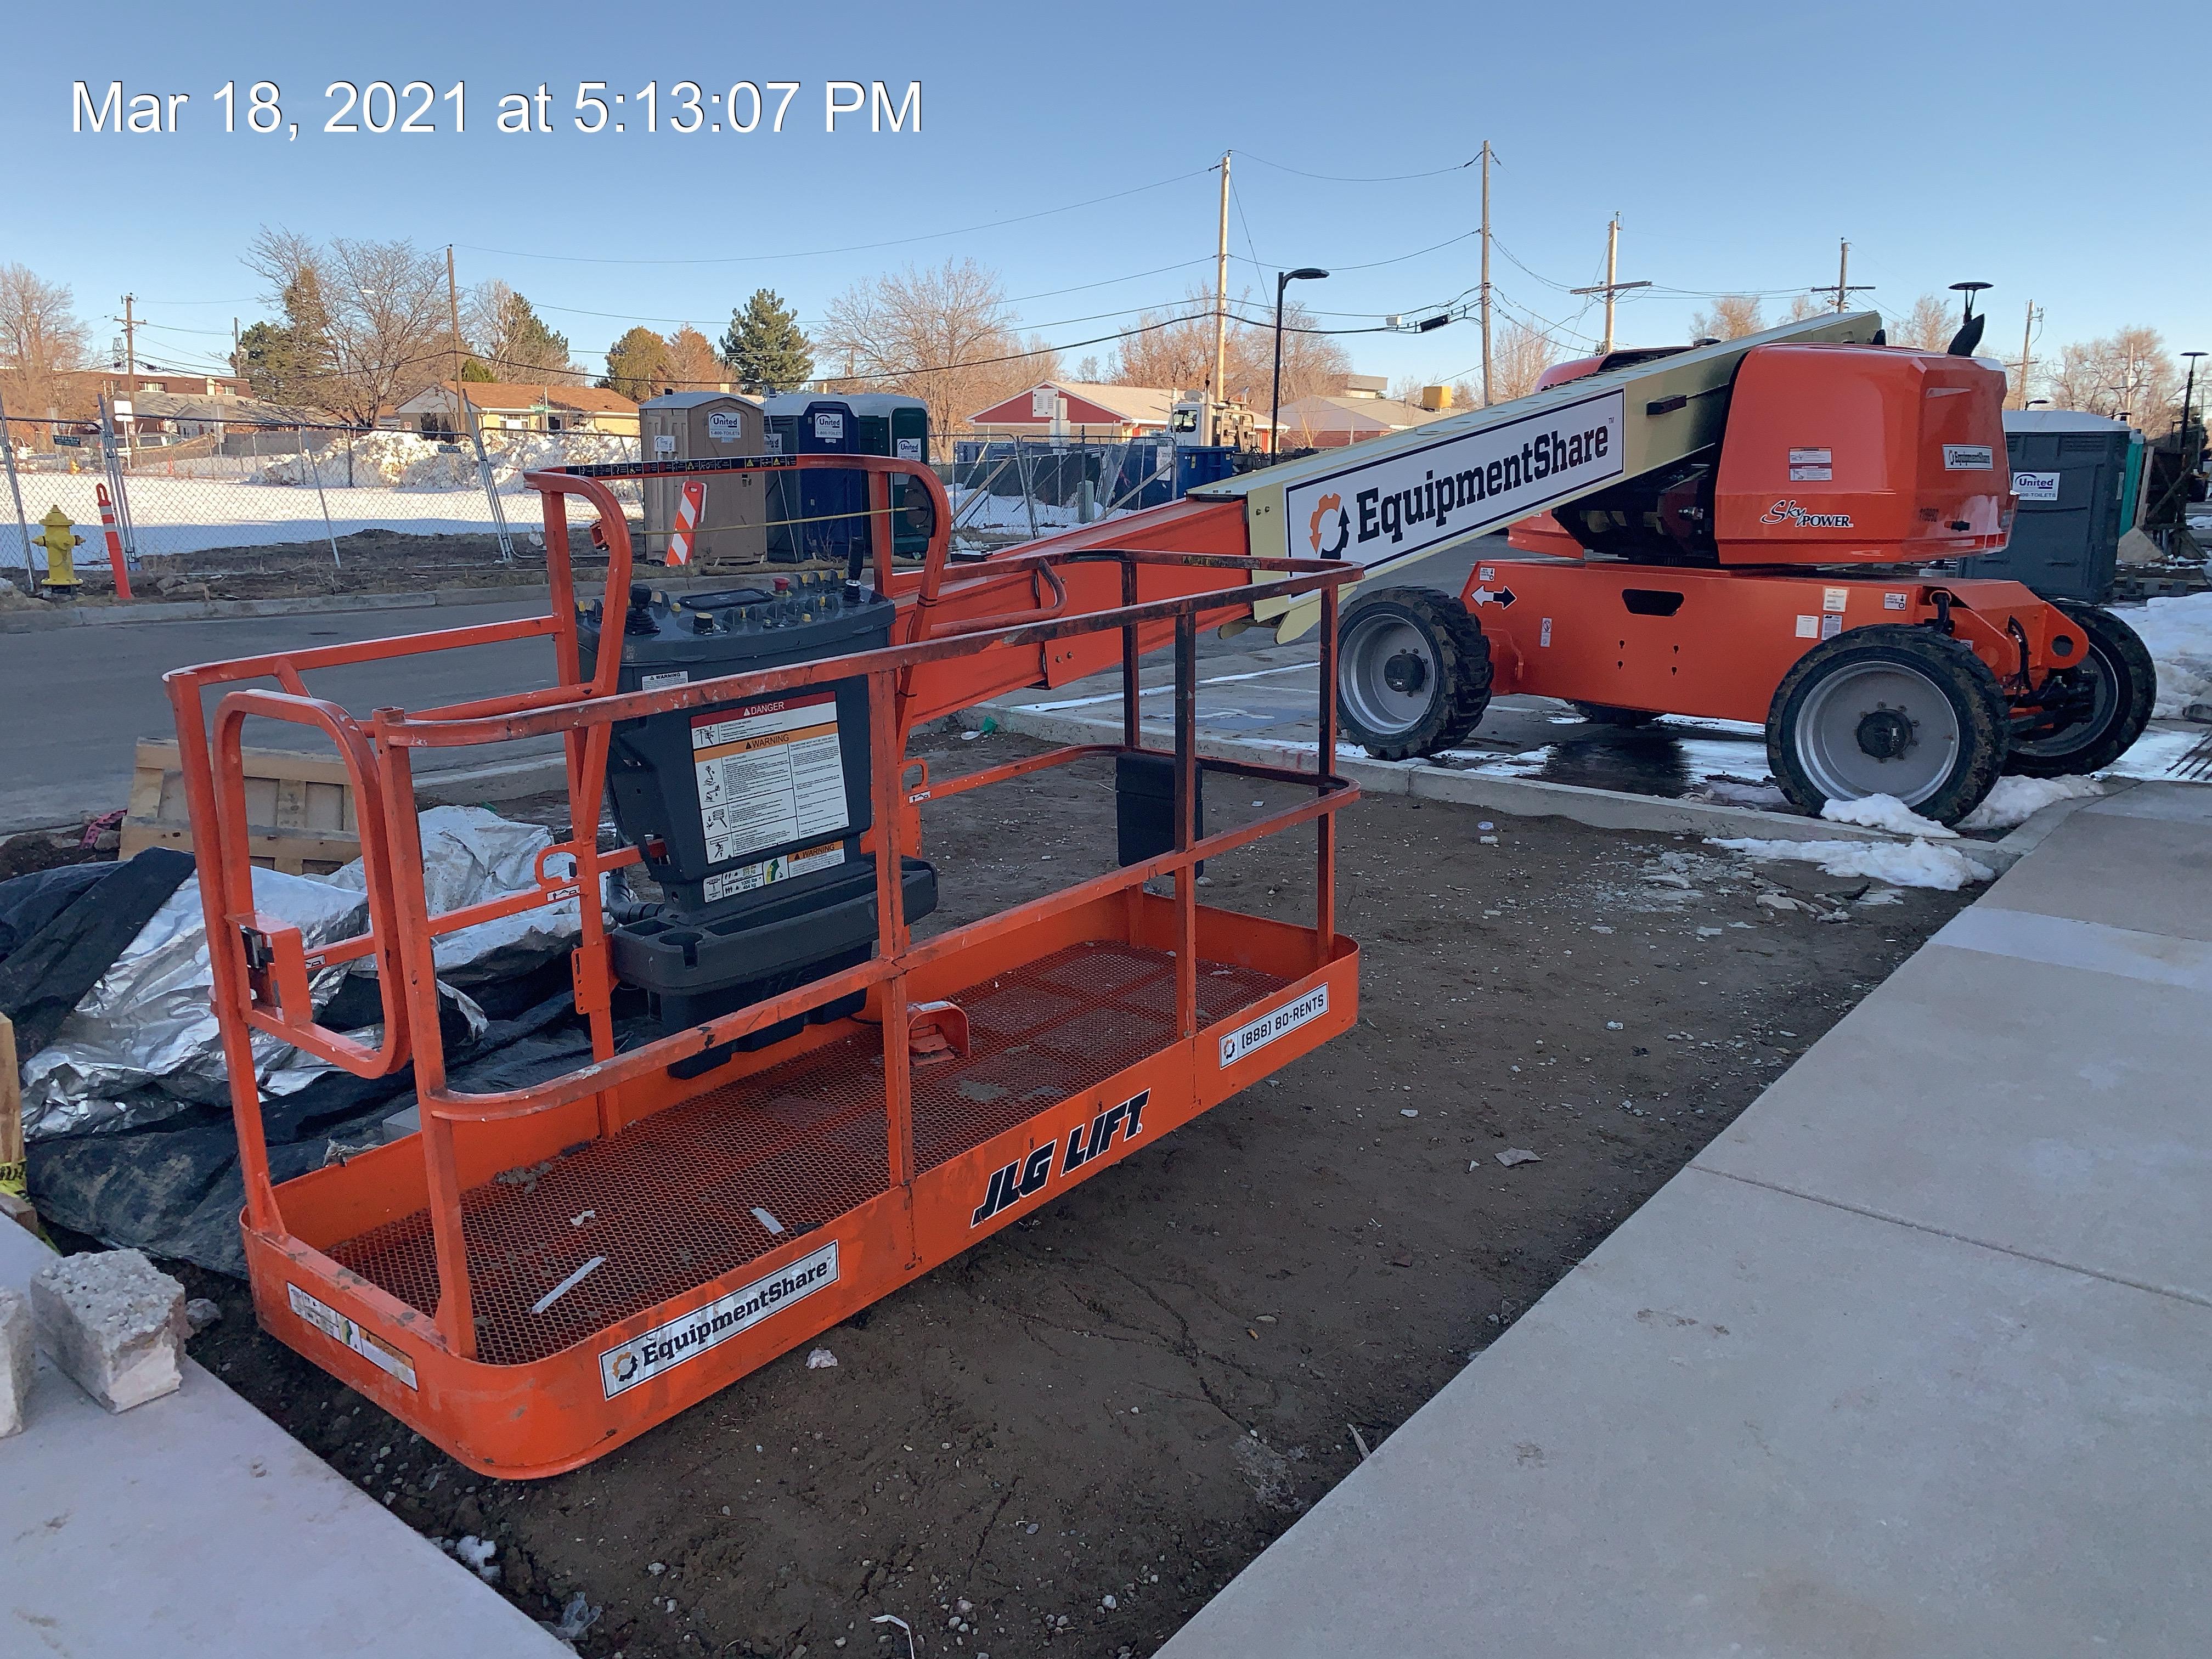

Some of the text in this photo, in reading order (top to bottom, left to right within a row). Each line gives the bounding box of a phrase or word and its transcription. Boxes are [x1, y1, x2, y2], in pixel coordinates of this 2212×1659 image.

[819, 418, 840, 426] United
[1356, 425, 1609, 544] EquipmentShare
[2019, 478, 2054, 487] United
[751, 701, 785, 715] DANGER
[752, 734, 789, 748] WARNING
[802, 844, 834, 857] WARNING
[1242, 994, 1324, 1048] (888) 80-RENTS
[970, 1088, 1151, 1229] JLG LIFT
[641, 1262, 827, 1366] EquipmentShare
